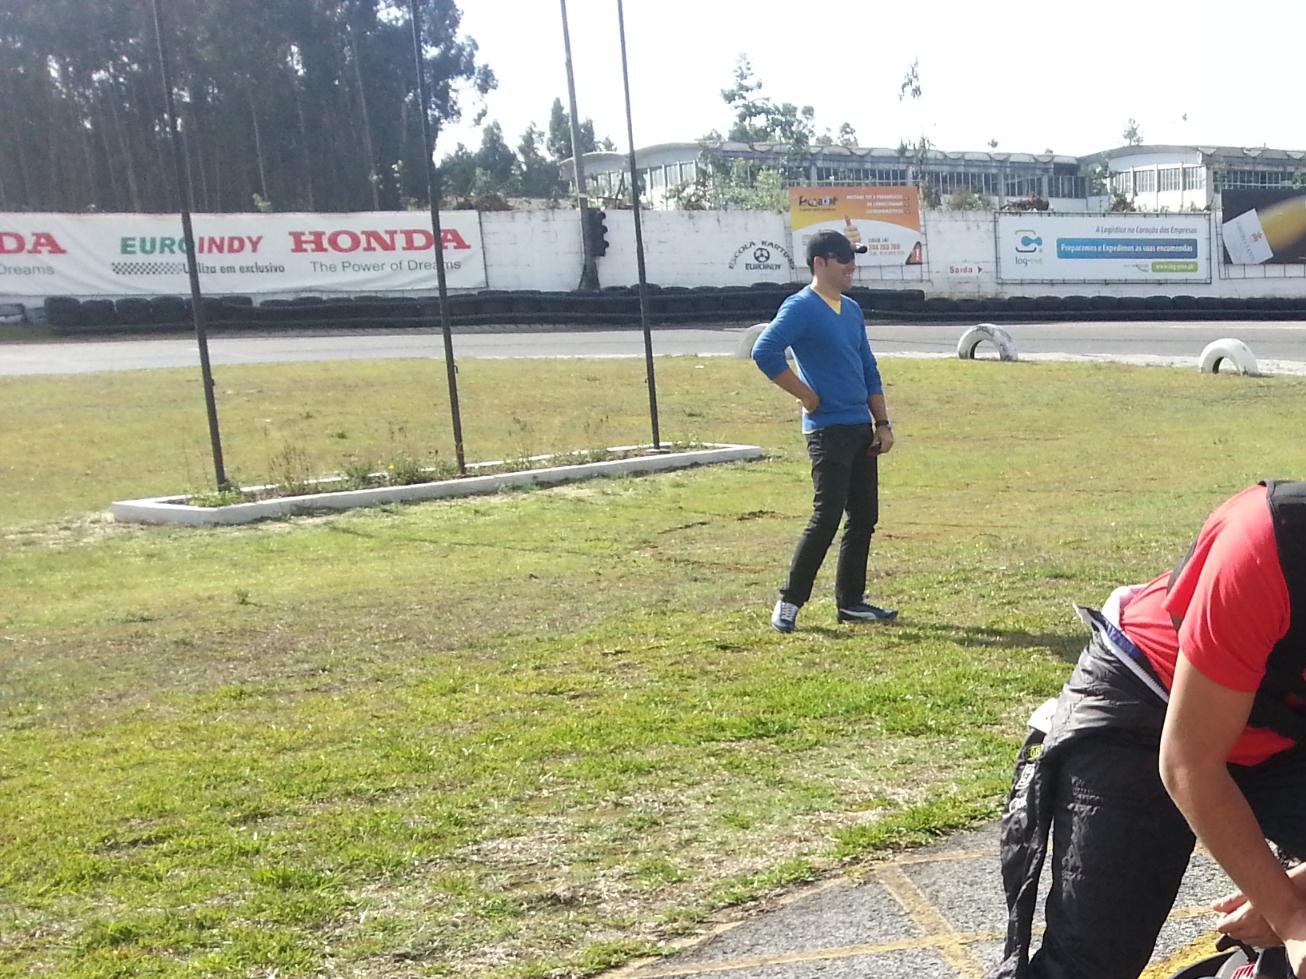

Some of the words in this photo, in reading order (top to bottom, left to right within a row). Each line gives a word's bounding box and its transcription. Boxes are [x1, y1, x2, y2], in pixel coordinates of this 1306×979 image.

[288, 229, 472, 253] HONDA
[219, 265, 236, 274] em
[239, 261, 286, 274] exclusivo
[310, 261, 337, 273] The
[341, 260, 385, 272] Power
[390, 260, 403, 271] of
